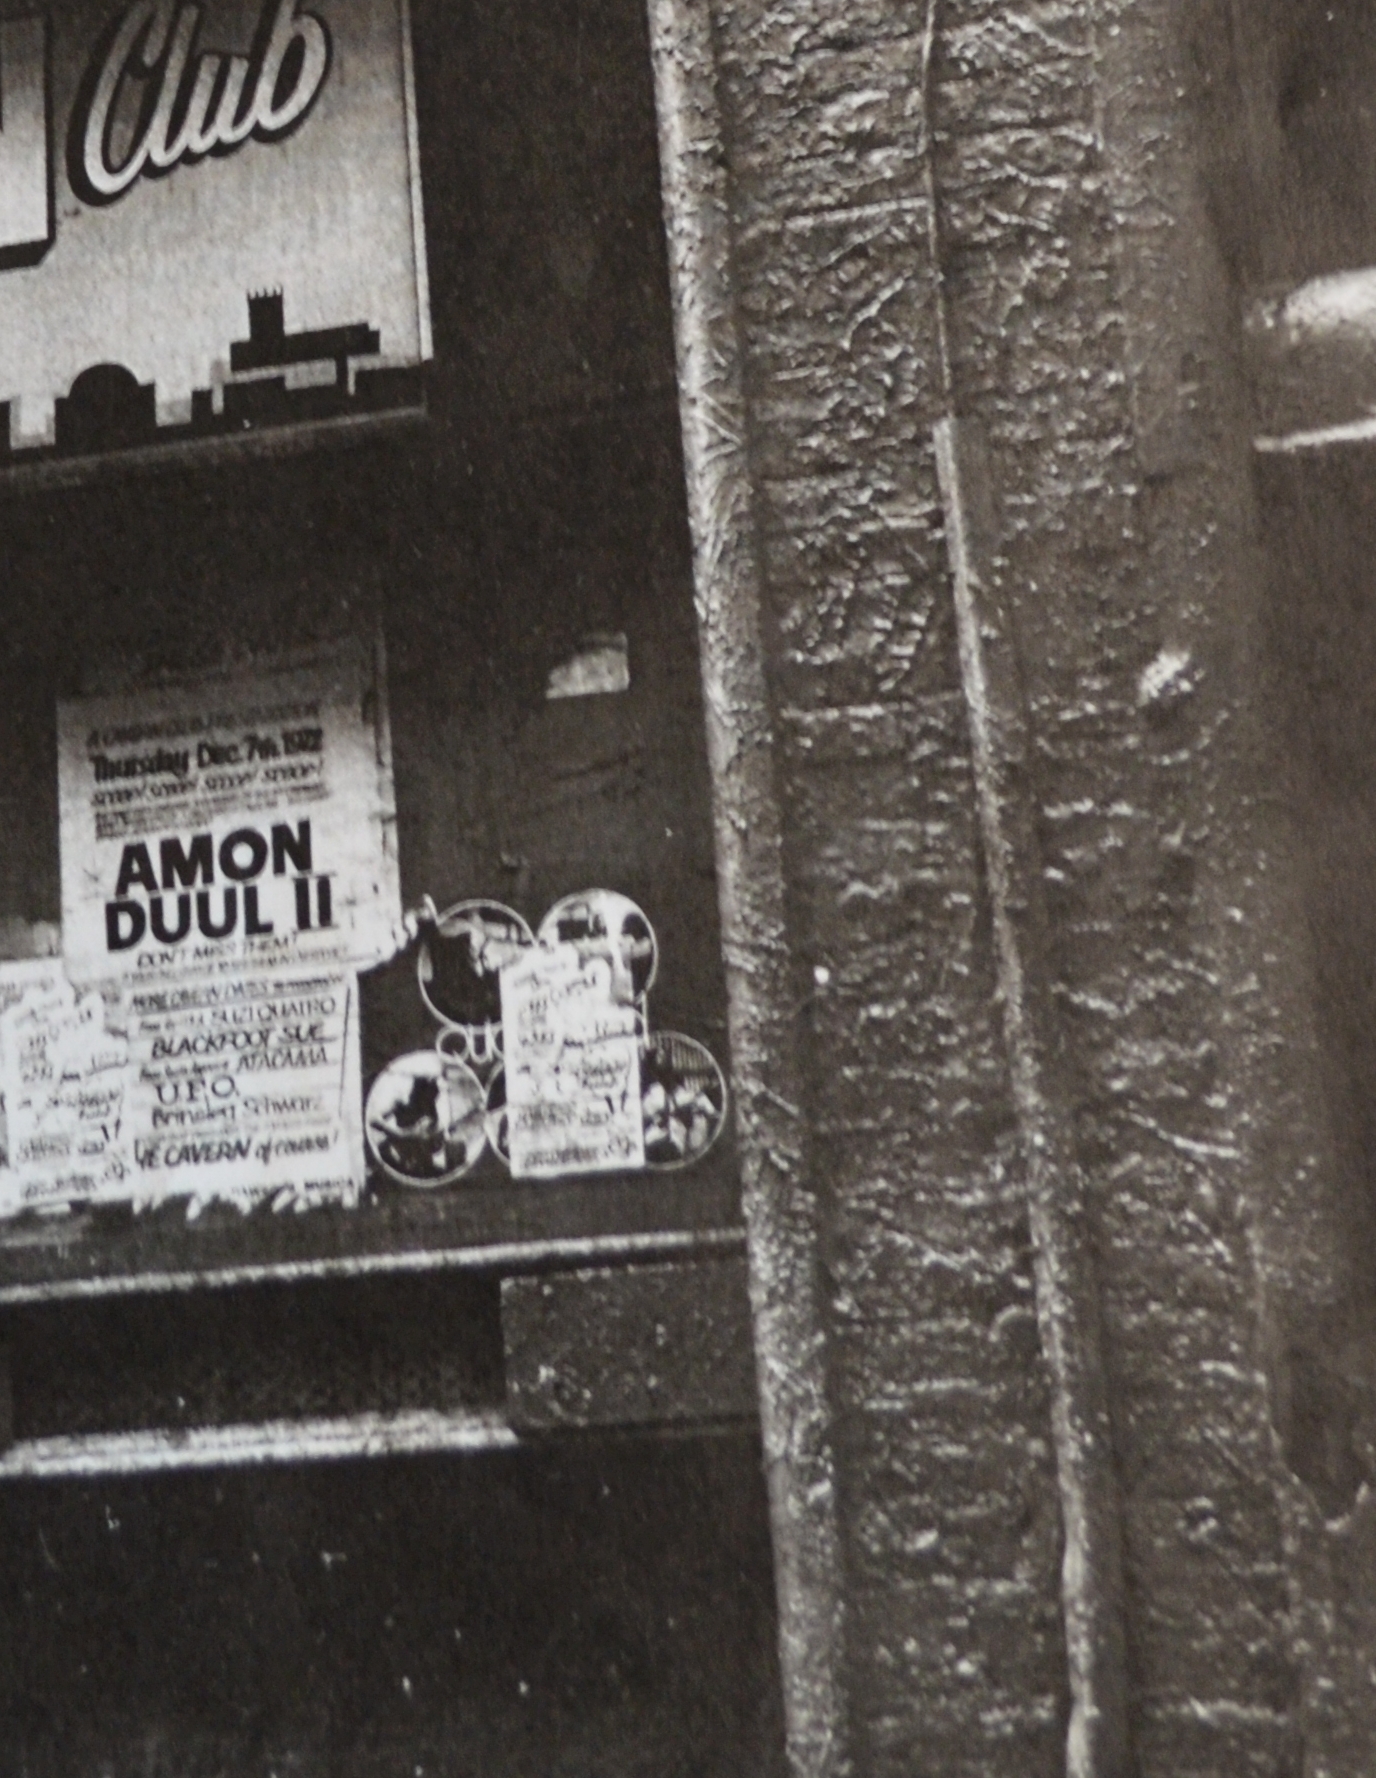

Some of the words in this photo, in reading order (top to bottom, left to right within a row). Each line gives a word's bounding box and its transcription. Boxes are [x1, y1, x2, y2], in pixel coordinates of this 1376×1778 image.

[115, 819, 313, 898] AMON
[105, 884, 274, 953] DUUL
[293, 873, 338, 931] II
[164, 1134, 252, 1168] CAVERN
